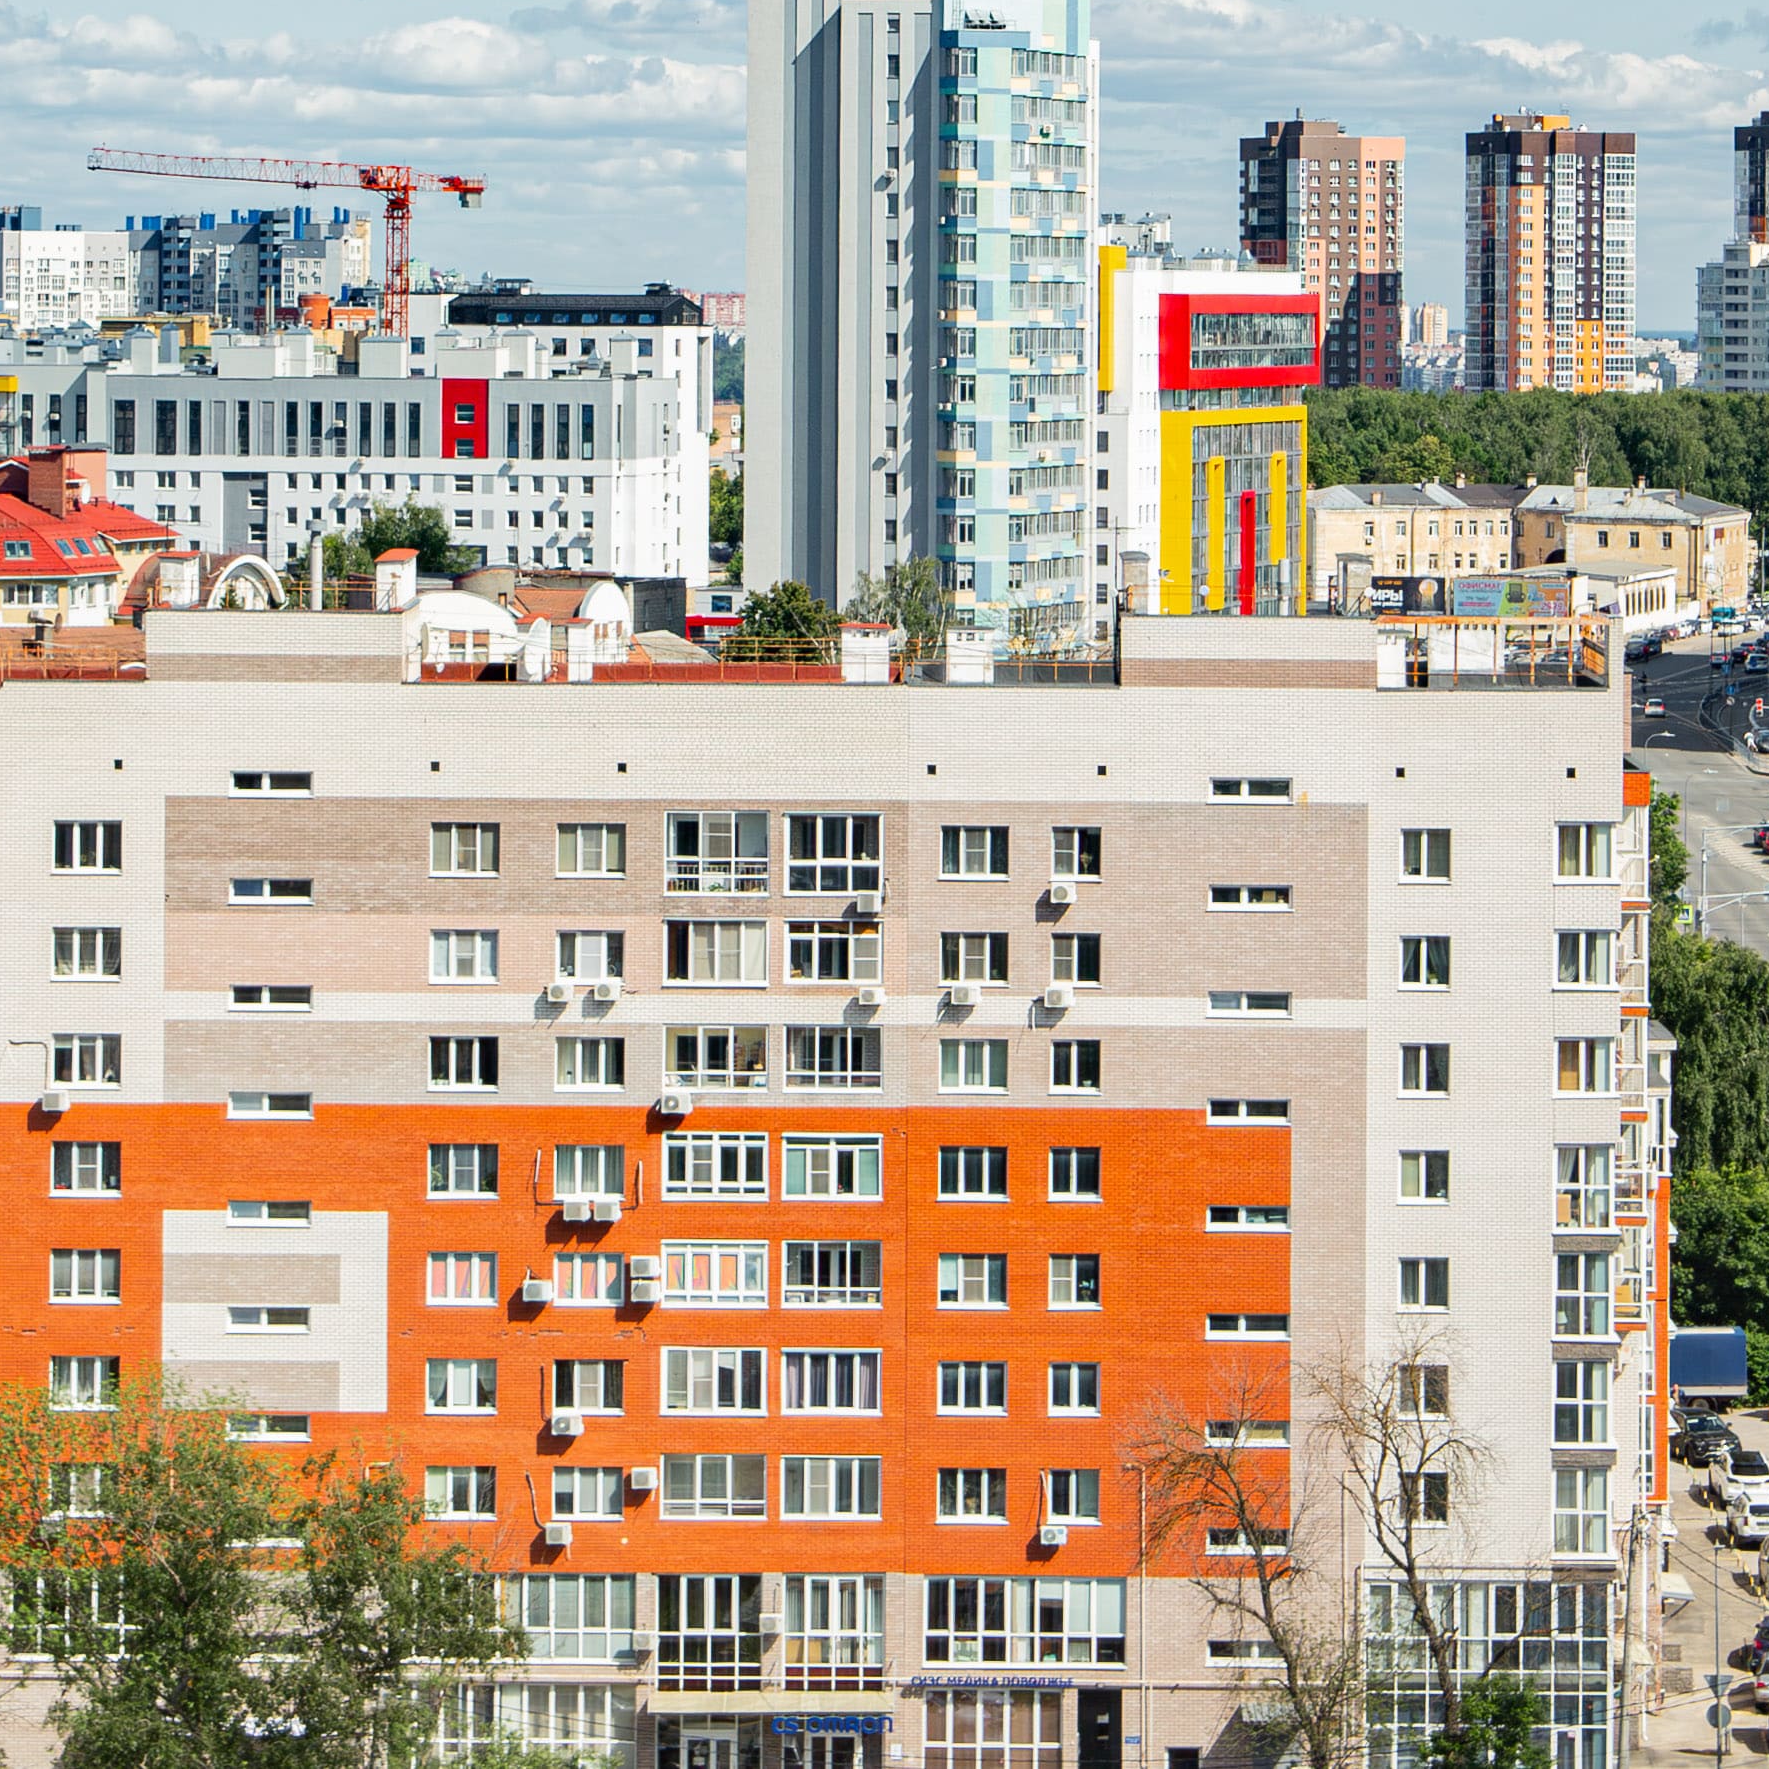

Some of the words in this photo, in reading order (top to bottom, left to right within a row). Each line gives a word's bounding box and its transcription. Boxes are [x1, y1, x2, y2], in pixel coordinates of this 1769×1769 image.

[946, 1676, 999, 1688] МЕДИКА
[1001, 1676, 1074, 1688] ПОВОЛЖЬЕ
[806, 1715, 894, 1735] OMRON
